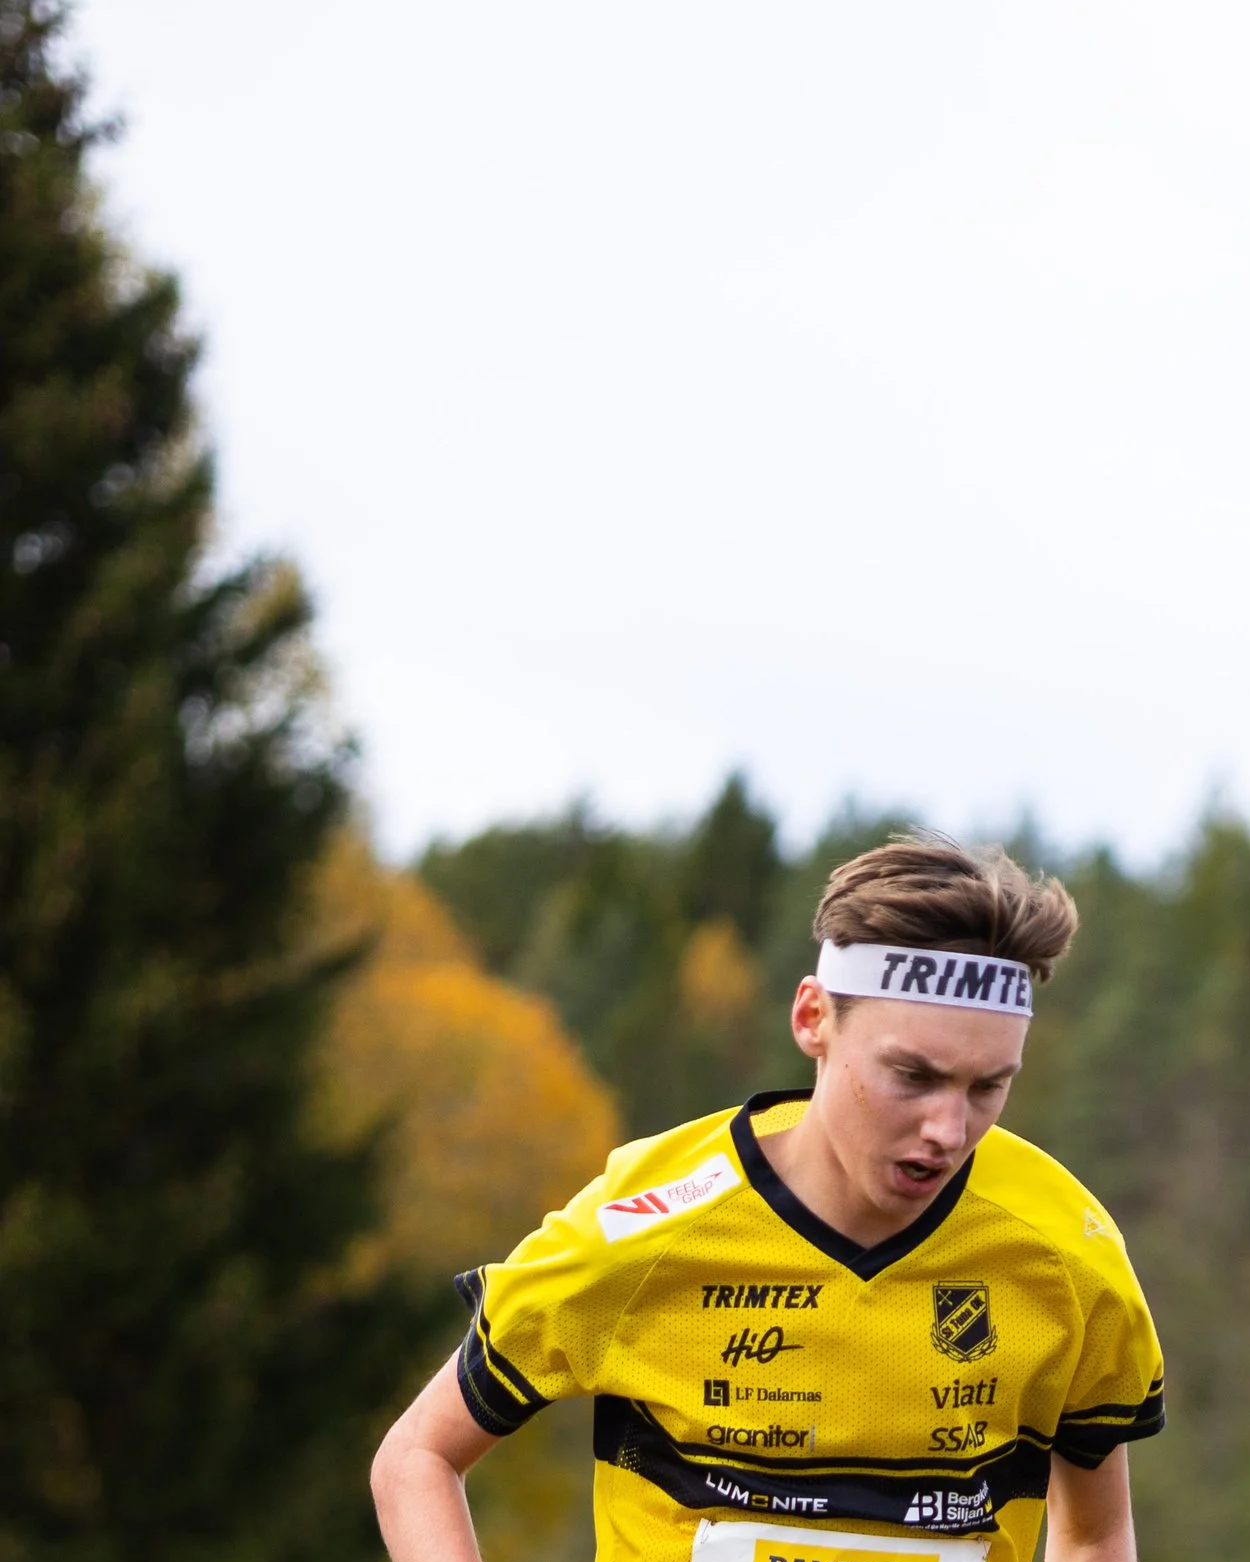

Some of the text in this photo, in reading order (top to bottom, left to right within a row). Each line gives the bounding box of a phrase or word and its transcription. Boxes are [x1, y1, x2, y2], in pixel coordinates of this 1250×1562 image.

[880, 953, 1030, 1008] TRIMTE
[667, 1180, 700, 1200] FEEL
[682, 1180, 713, 1204] GRIP
[702, 1284, 824, 1309] TRIMTEX
[735, 1387, 823, 1402] LF Dalarnas
[930, 1377, 998, 1409] viati
[707, 1425, 809, 1448] granitor
[928, 1420, 989, 1451] SSAB
[947, 1479, 989, 1507] Bergk
[947, 1506, 984, 1523] Siljan
